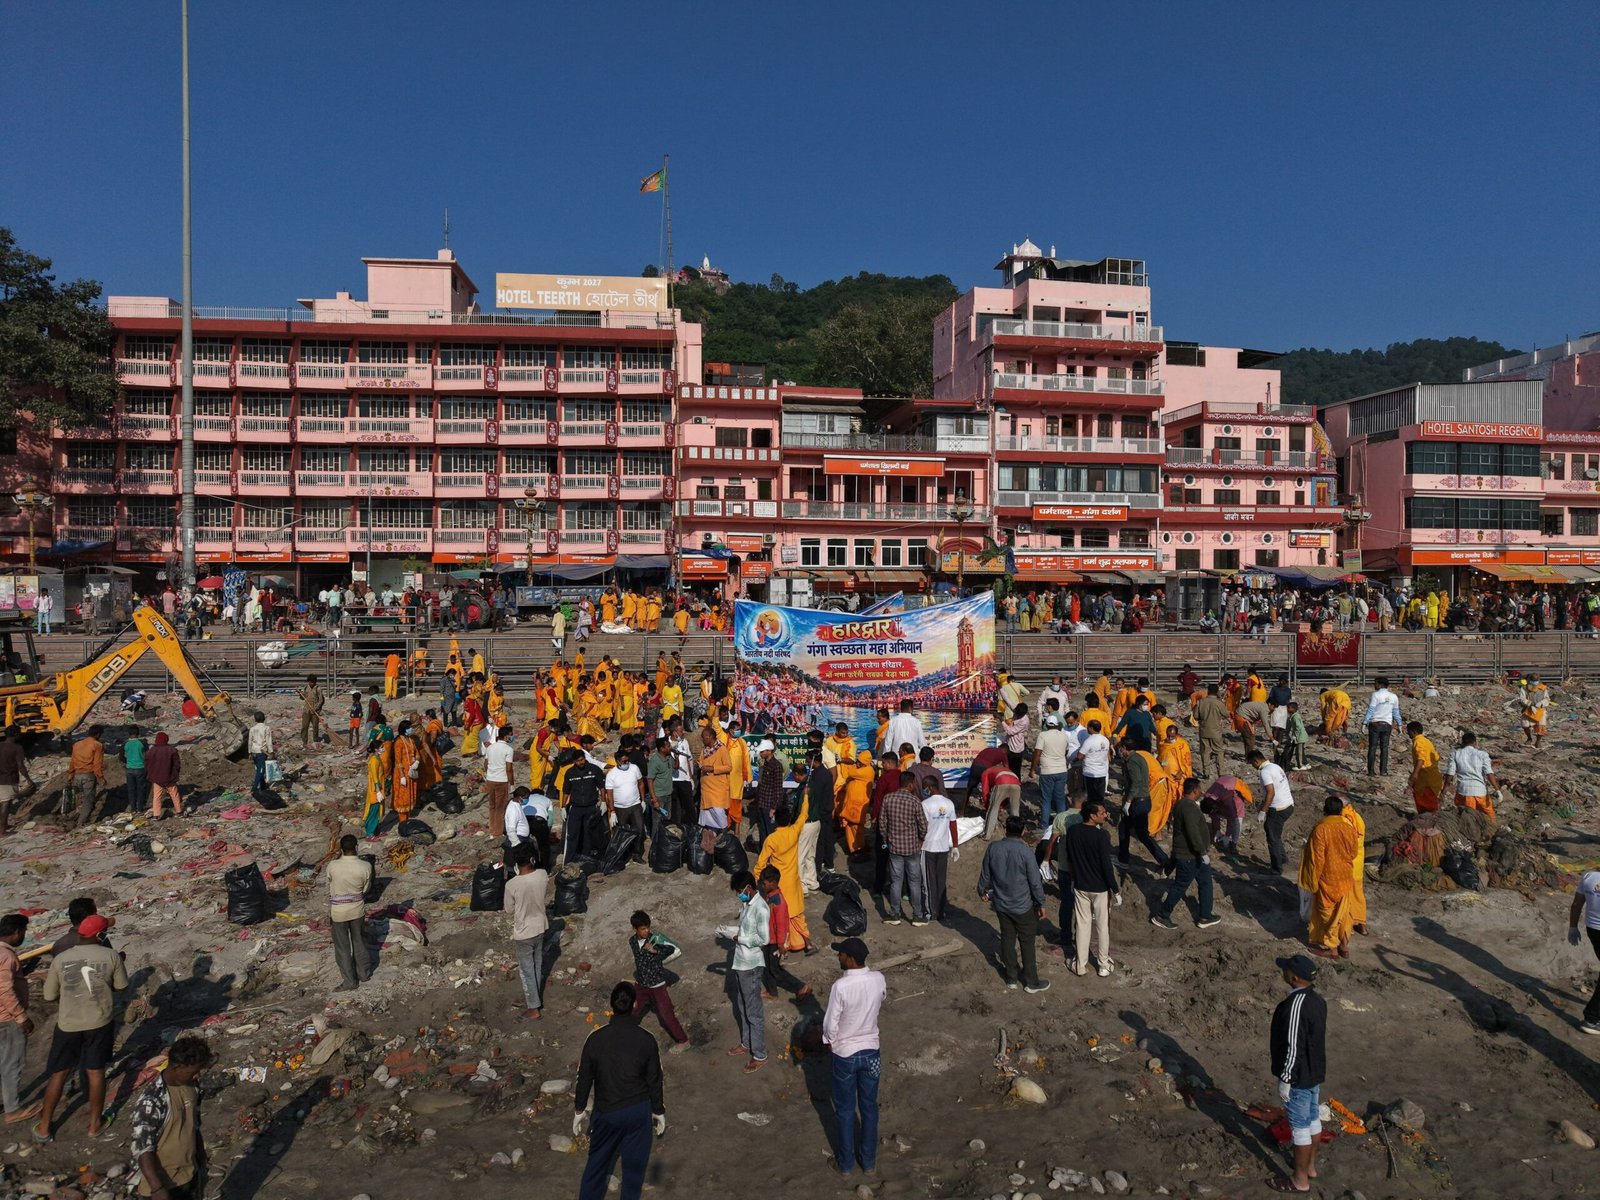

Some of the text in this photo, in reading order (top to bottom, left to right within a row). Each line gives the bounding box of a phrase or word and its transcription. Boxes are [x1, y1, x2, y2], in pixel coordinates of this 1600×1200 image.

[582, 278, 602, 287] 2027
[496, 289, 580, 305] HOTEL TEERTH
[586, 288, 660, 308] হোটেল তীর্থ
[1427, 422, 1539, 437] HOTEL SANTOSH REGENCY
[1039, 507, 1072, 515] धर्मशाला
[1102, 507, 1121, 515] दर्शन
[744, 648, 763, 658] भारतीय
[763, 648, 774, 658] नदी
[807, 639, 923, 657] गंगा स्वच्छता महा अभियान
[89, 656, 127, 691] JCB
